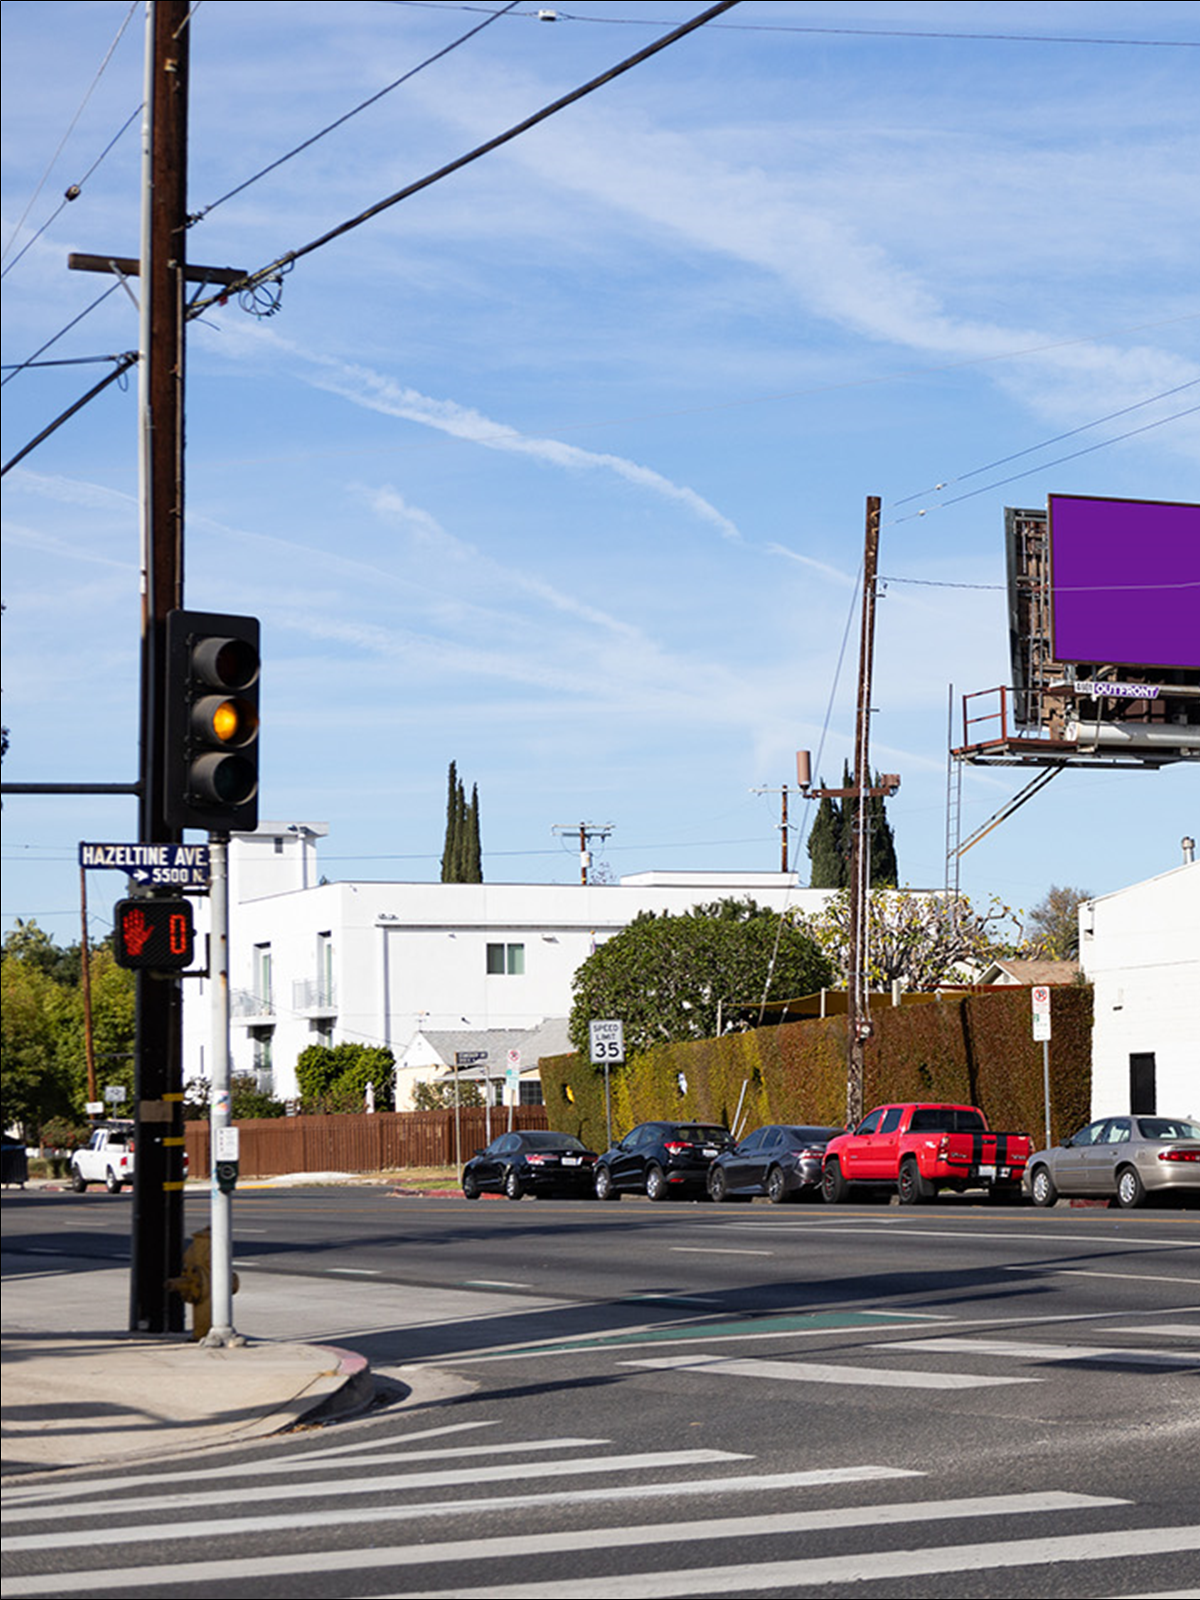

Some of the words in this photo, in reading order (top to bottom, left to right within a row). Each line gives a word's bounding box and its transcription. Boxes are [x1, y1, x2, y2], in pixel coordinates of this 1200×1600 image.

[1096, 683, 1158, 698] OUTFRONT
[82, 846, 169, 866] HAZELTINE
[152, 868, 188, 882] 5500
[593, 1023, 619, 1032] SPEED
[595, 1033, 616, 1041] LIMIT
[595, 1042, 620, 1058] 35
